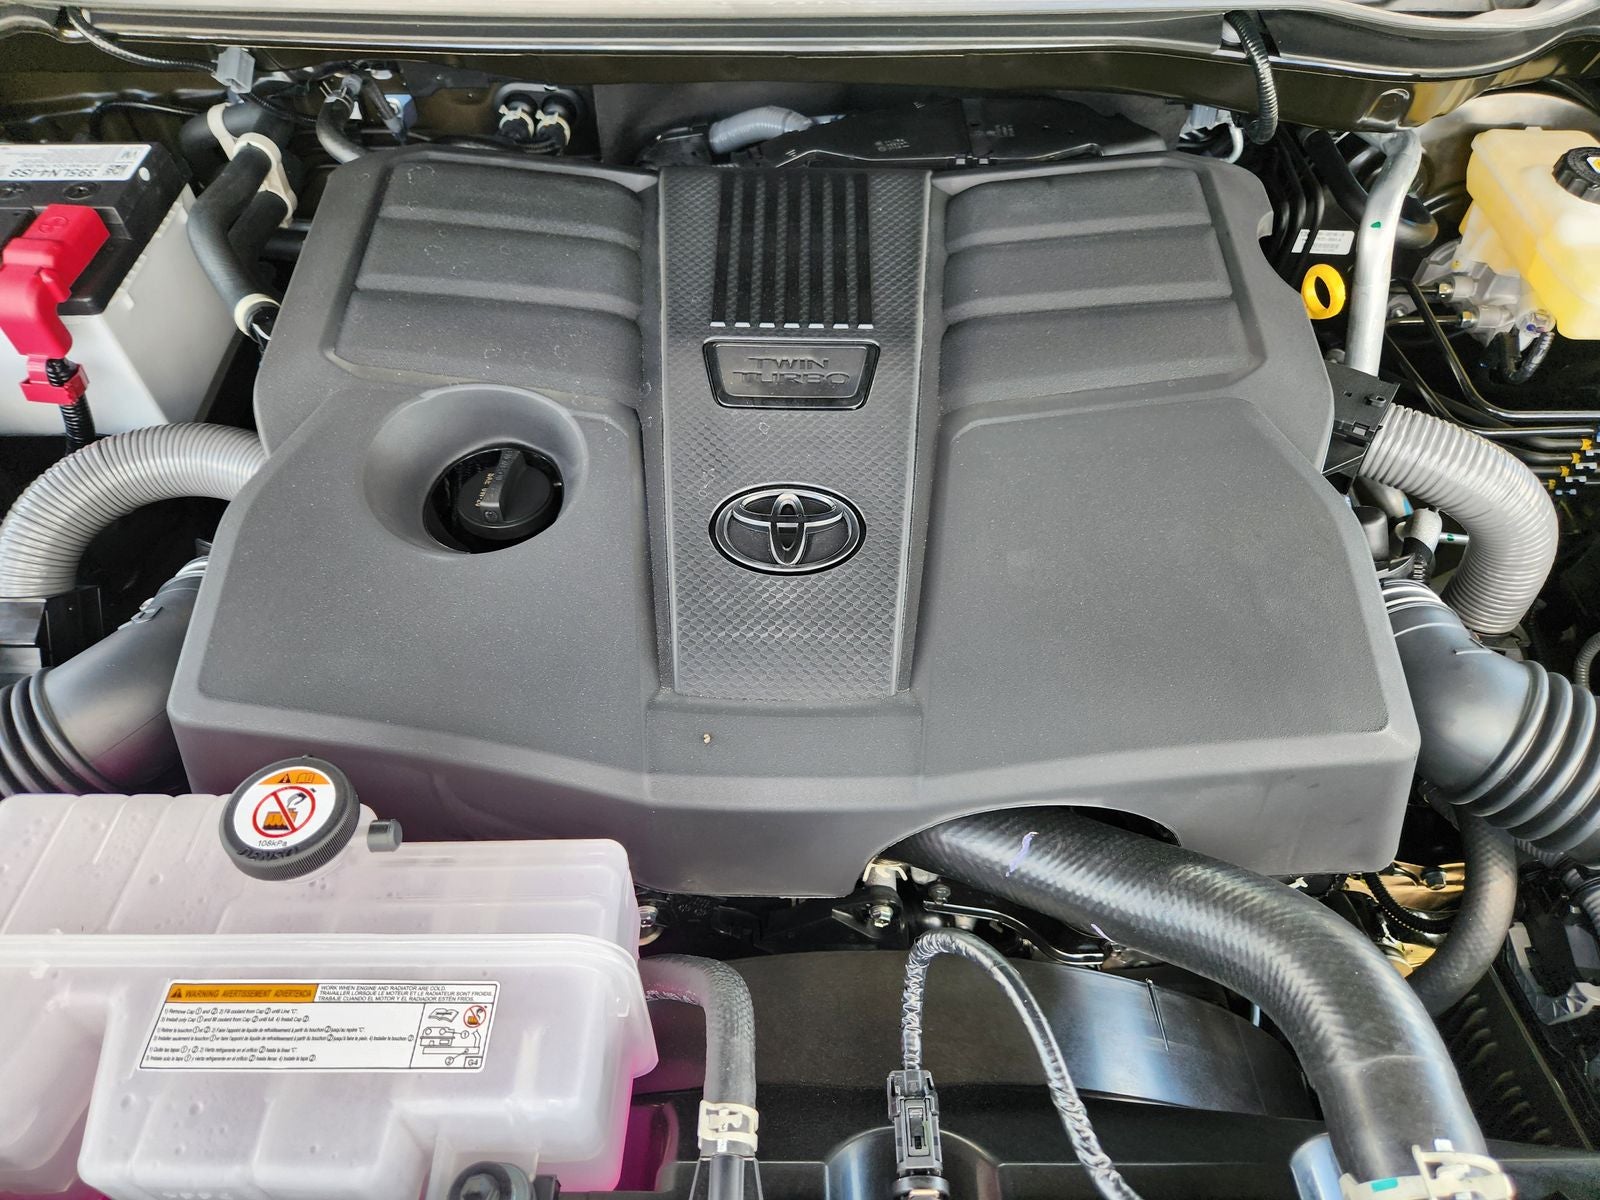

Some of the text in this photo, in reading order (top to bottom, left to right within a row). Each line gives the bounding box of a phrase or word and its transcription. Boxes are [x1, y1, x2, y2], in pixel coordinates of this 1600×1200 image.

[748, 357, 829, 370] TWIN
[732, 371, 850, 385] TURBO
[258, 839, 288, 848] 108kPa
[185, 989, 219, 998] WARNING
[222, 989, 271, 998] AVERTISSEMENT
[467, 1058, 479, 1067] G4
